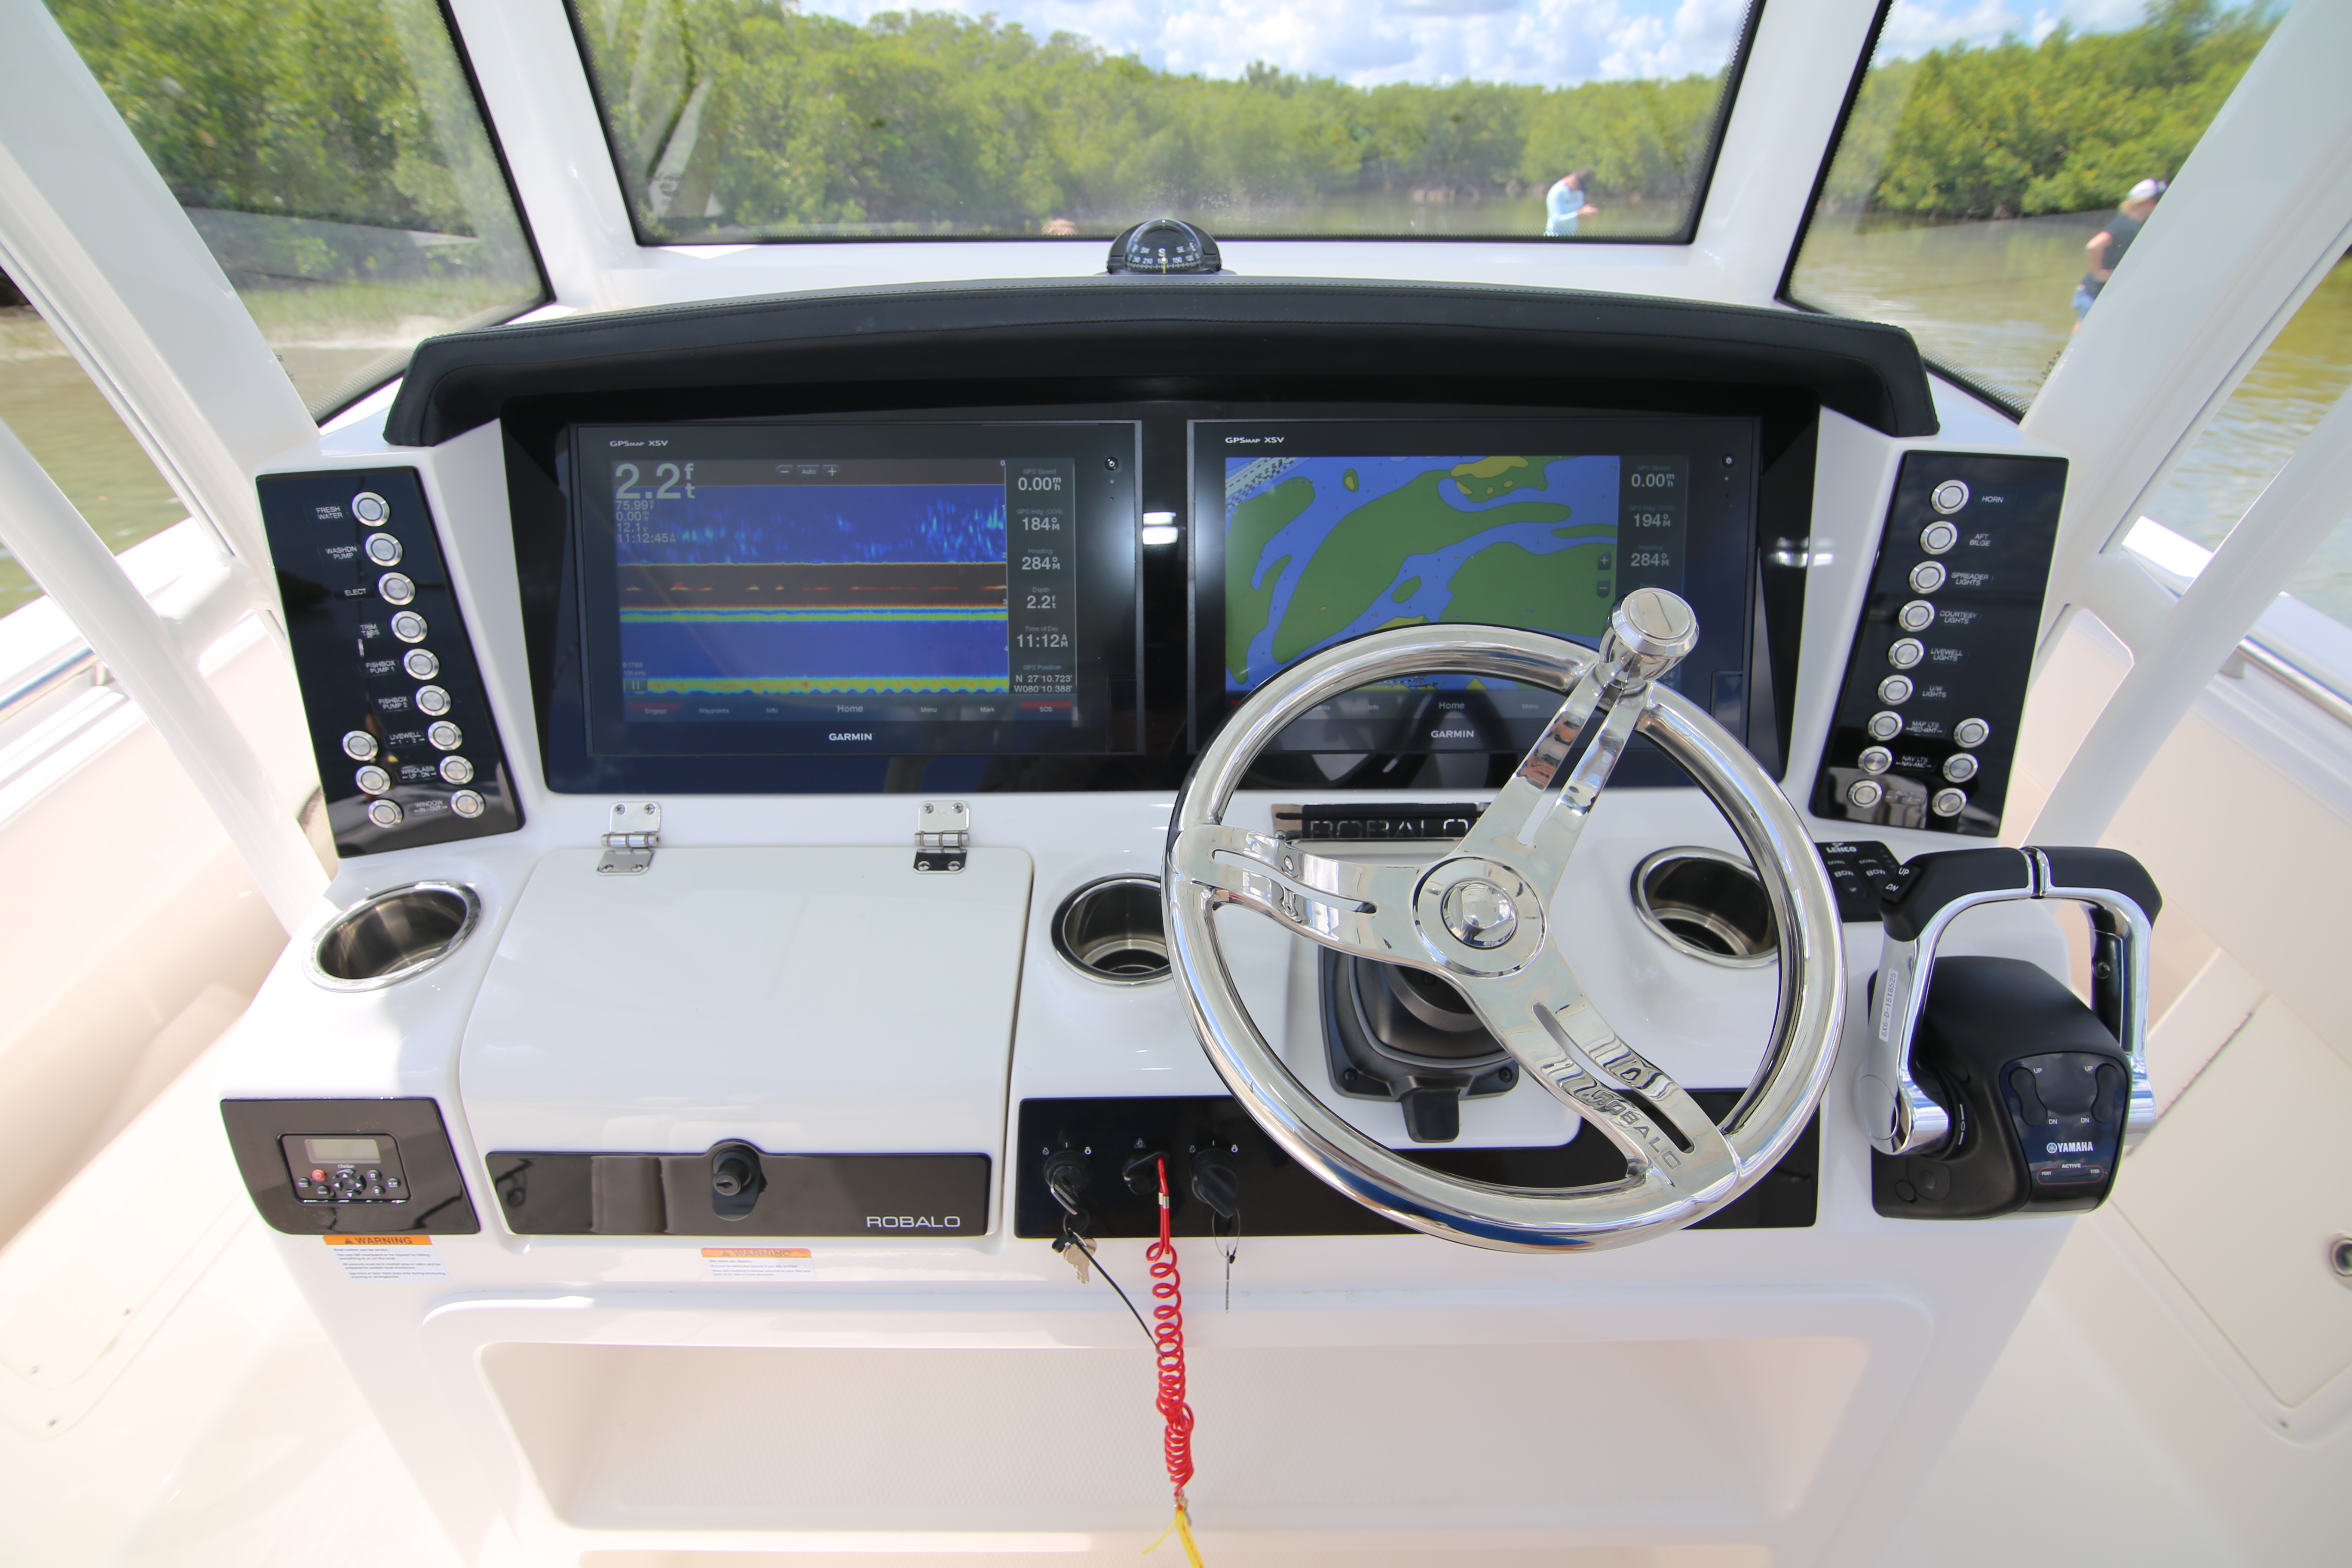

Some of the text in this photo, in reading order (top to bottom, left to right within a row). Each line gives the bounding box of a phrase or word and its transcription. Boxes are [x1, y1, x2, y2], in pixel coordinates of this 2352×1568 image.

[1158, 248, 1166, 257] S
[616, 462, 681, 499] 2.2
[1017, 477, 1052, 491] 0.00
[1631, 473, 1665, 487] 0.00
[316, 506, 341, 514] FRESH
[616, 500, 648, 511] 75.99
[317, 512, 343, 520] WATER
[616, 511, 642, 521] 0.00
[1633, 514, 1661, 527] 194
[617, 523, 640, 533] 12.1
[1022, 517, 1050, 531] 184
[617, 533, 669, 543] 11:12:45
[325, 546, 358, 555] WASHDN
[334, 551, 354, 560] PUMP
[1631, 553, 1660, 567] 284
[1022, 556, 1051, 570] 284
[1951, 572, 1989, 581] SPREADER
[344, 588, 367, 596] ELECT
[1027, 595, 1051, 609] 2.2
[1940, 610, 1977, 619] COURTESY
[1944, 616, 1969, 625] LIGHTS
[1017, 634, 1060, 647] 11:12
[1930, 648, 1963, 657] LIVEWELL
[365, 660, 395, 668] FISHBOX
[378, 696, 407, 704] FISHBOX
[1439, 701, 1465, 709] Home
[389, 732, 422, 740] LIVEWELL
[828, 733, 873, 741] GARMIN
[1430, 730, 1474, 738] GARMIN
[401, 766, 435, 775] WINDLASS
[415, 799, 443, 808] WINDOW
[1899, 867, 1910, 876] UP
[1885, 883, 1899, 891] DN
[2057, 1142, 2094, 1152] YAMAHA
[866, 1216, 961, 1228] ROBALO
[355, 1237, 413, 1245] WARNING
[734, 1250, 792, 1258] WARNING
